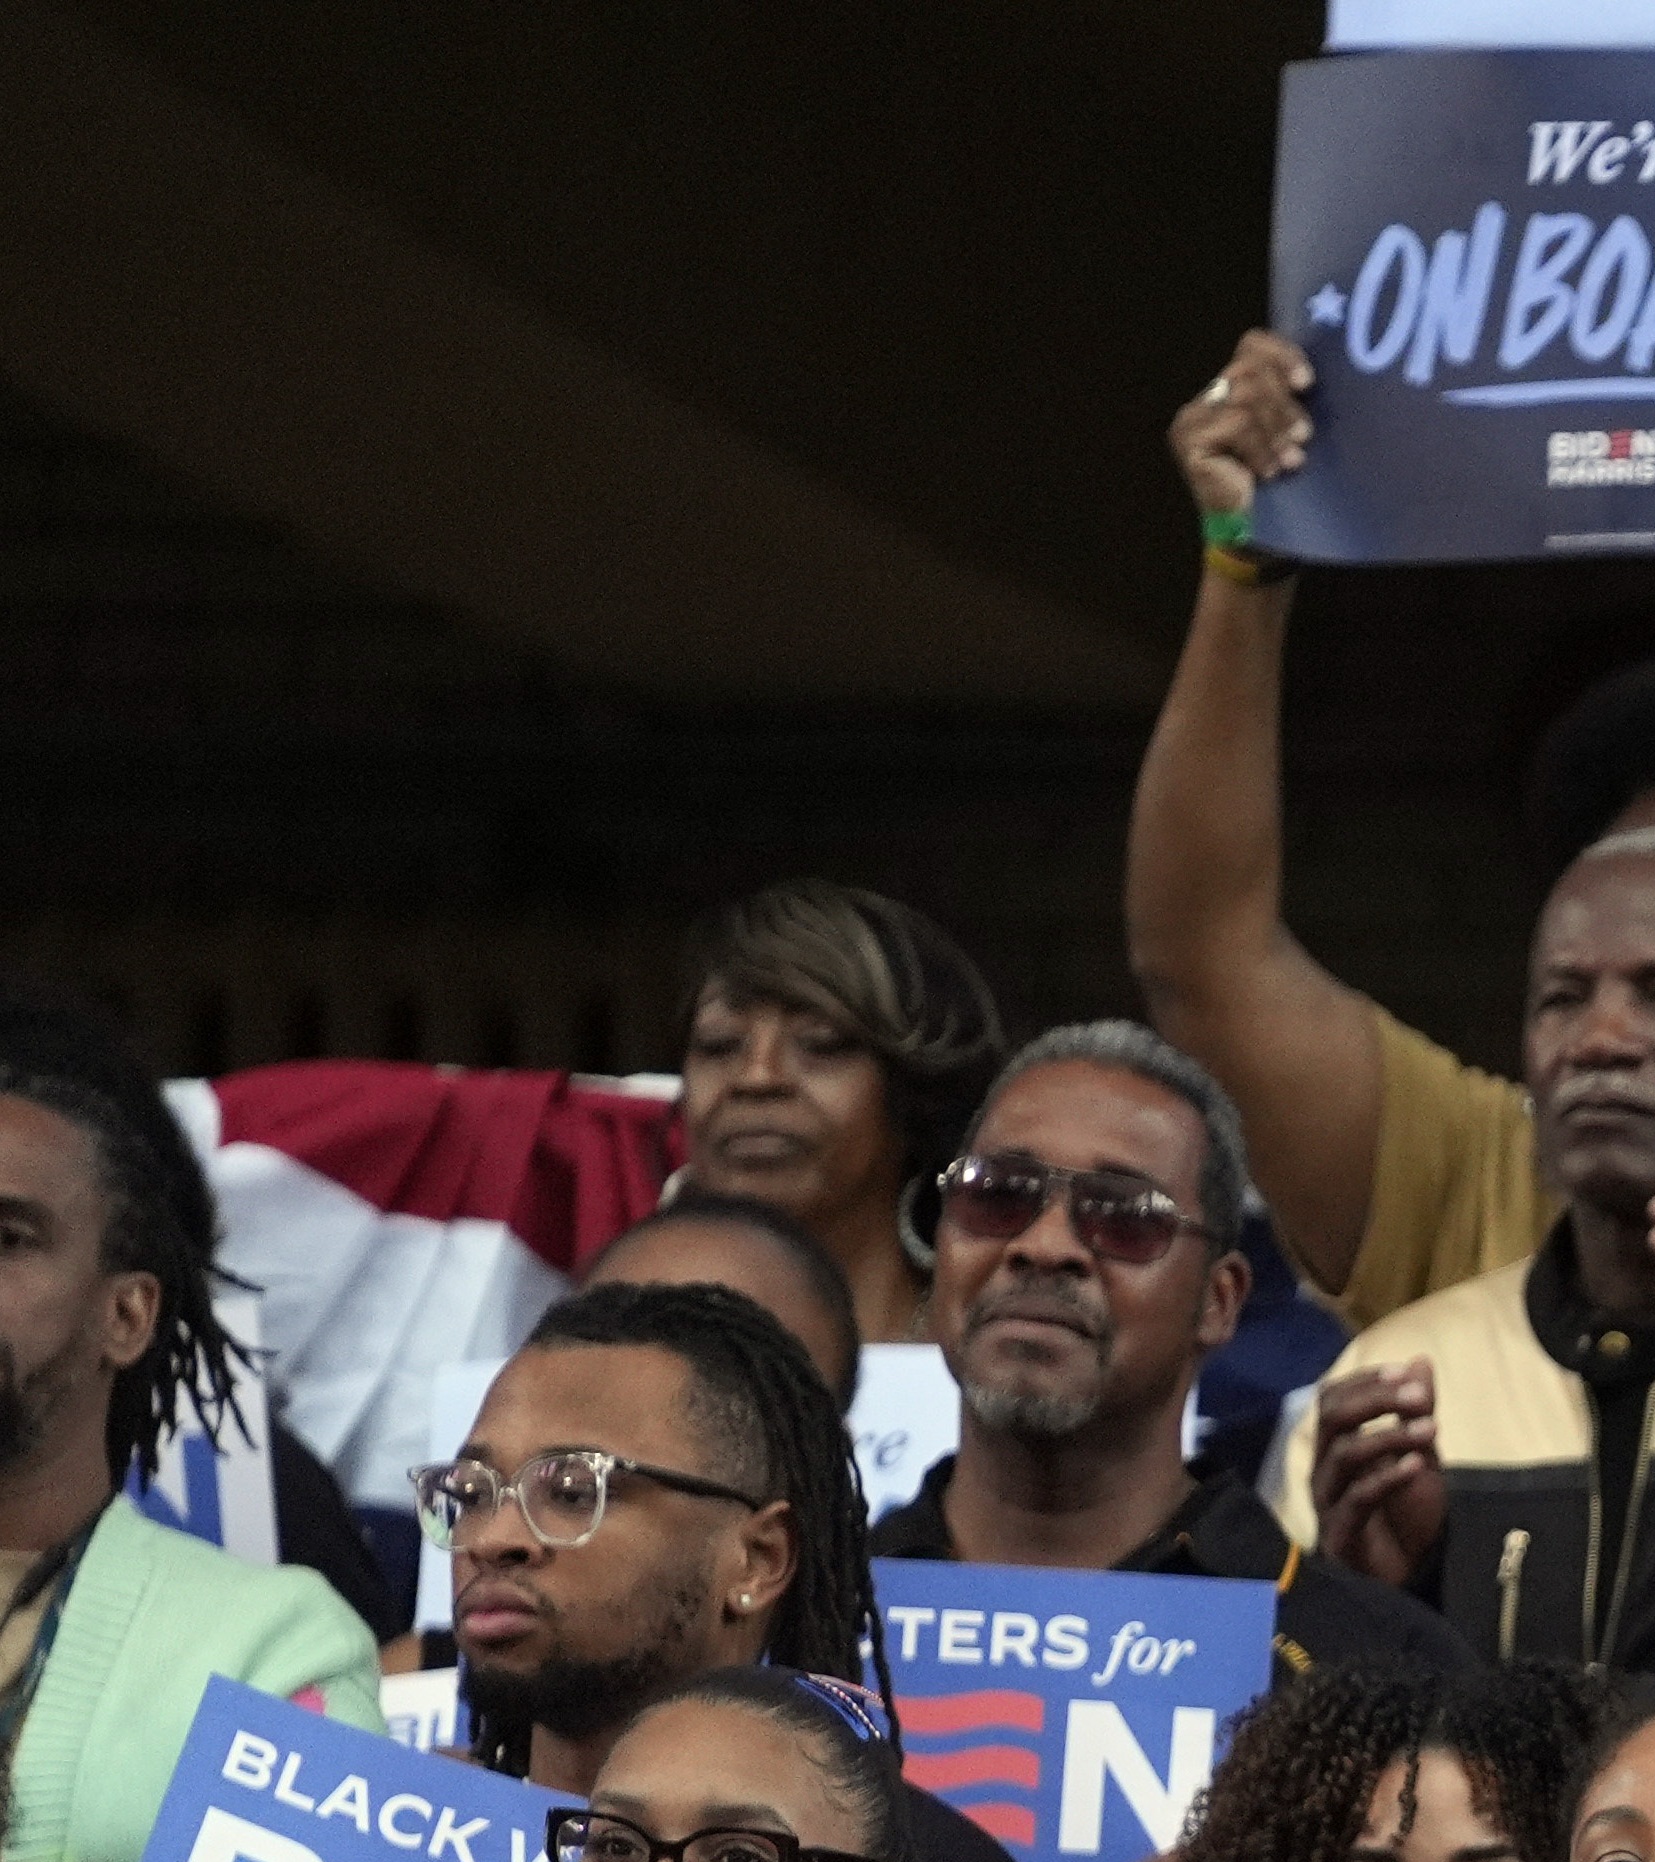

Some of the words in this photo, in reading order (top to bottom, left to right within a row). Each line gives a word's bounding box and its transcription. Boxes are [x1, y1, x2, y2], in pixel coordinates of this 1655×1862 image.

[1347, 201, 1508, 386] ON
[888, 1607, 1090, 1670] TERS
[1092, 1620, 1197, 1687] for
